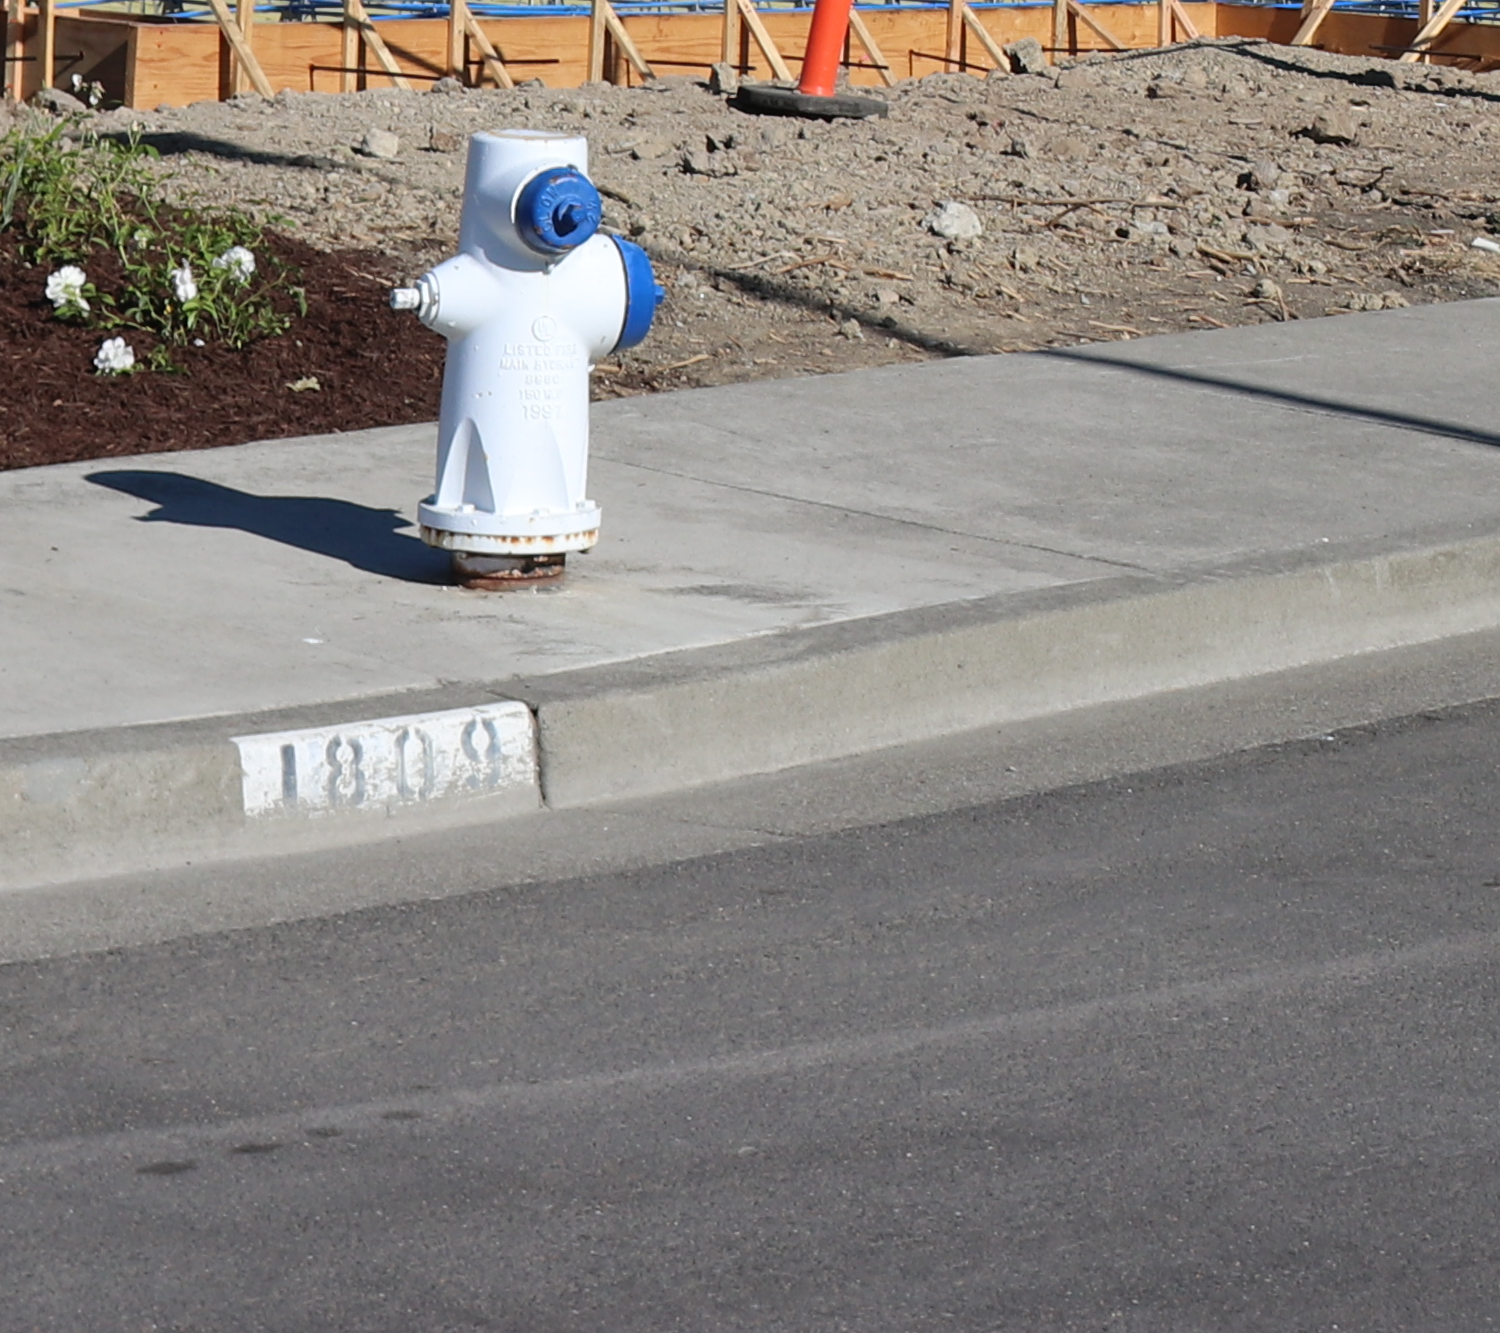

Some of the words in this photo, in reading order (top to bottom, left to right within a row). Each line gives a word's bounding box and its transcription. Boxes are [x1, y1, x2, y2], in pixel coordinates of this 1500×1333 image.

[503, 343, 551, 356] LISTED
[499, 357, 530, 371] MAIN
[280, 716, 501, 806] 1809
